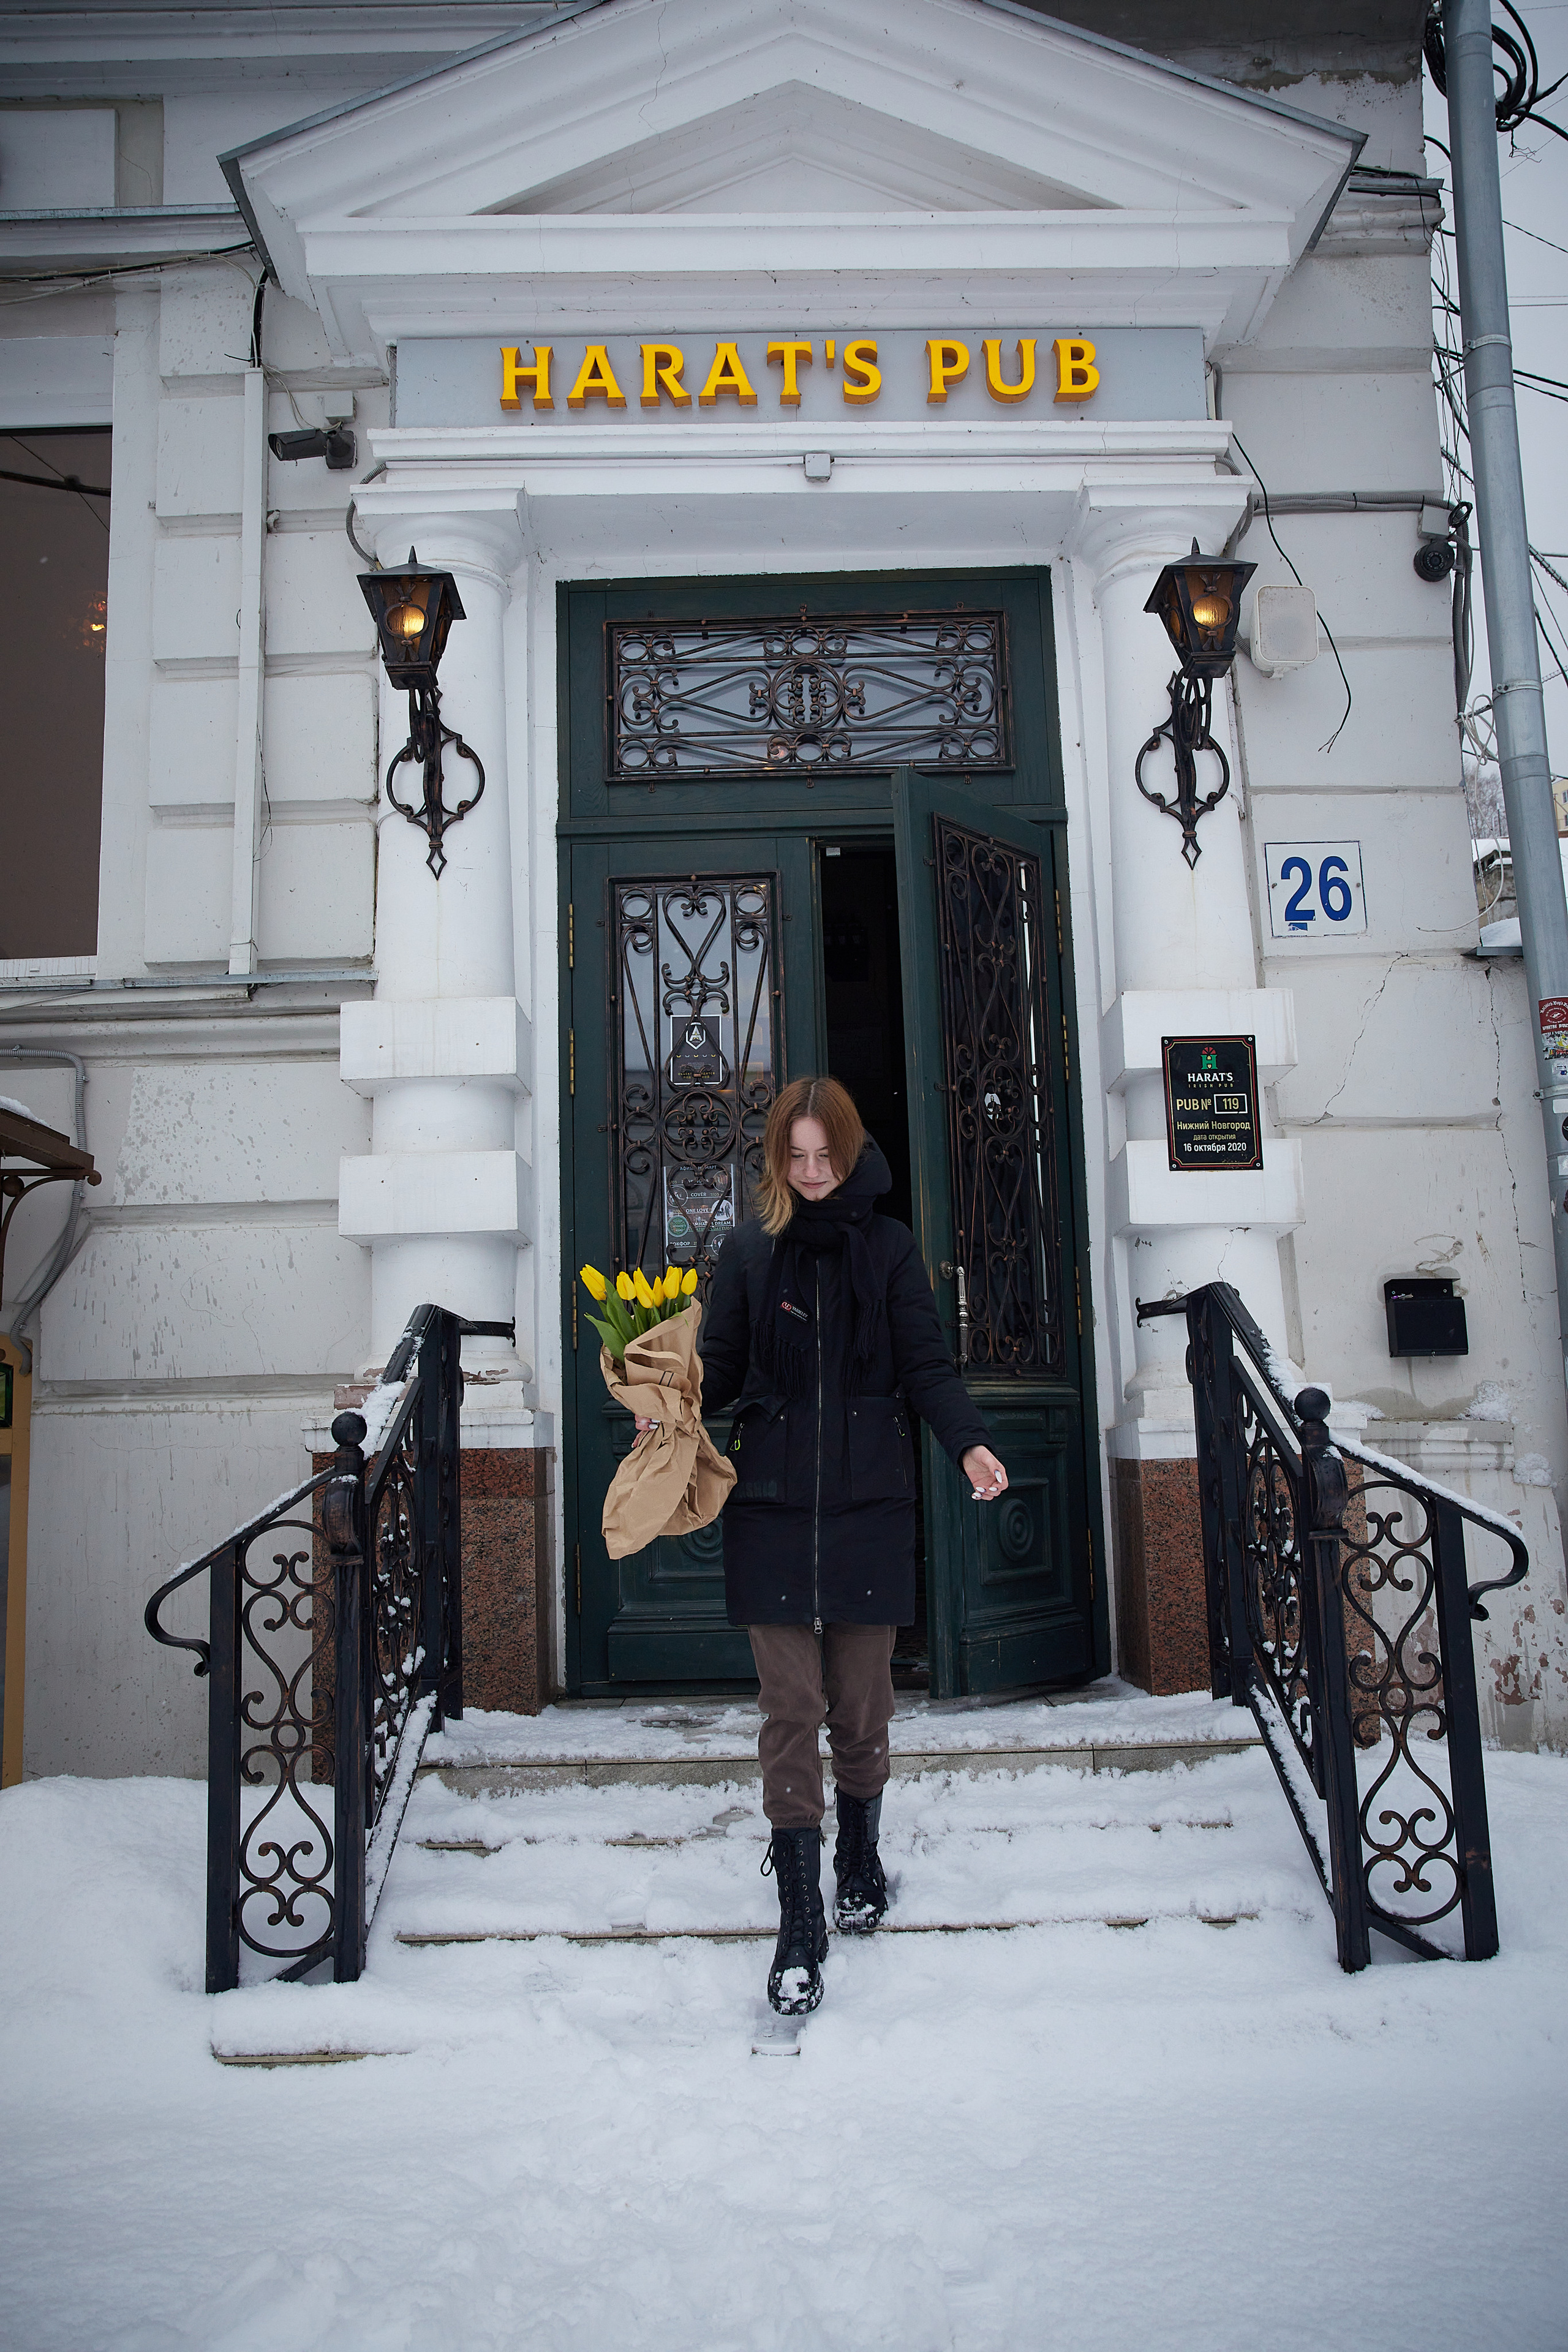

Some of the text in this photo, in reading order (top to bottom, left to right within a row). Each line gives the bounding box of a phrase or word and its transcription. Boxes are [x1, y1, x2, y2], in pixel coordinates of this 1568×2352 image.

[500, 339, 1100, 410] HARAT'S PUB
[1281, 856, 1352, 921] 26
[1188, 1072, 1234, 1082] HARAT'S
[1176, 1099, 1199, 1110] PUB
[1223, 1098, 1239, 1110] 119
[1177, 1120, 1251, 1131] Нижний Новгород
[1183, 1142, 1247, 1153] 16 октября 2020
